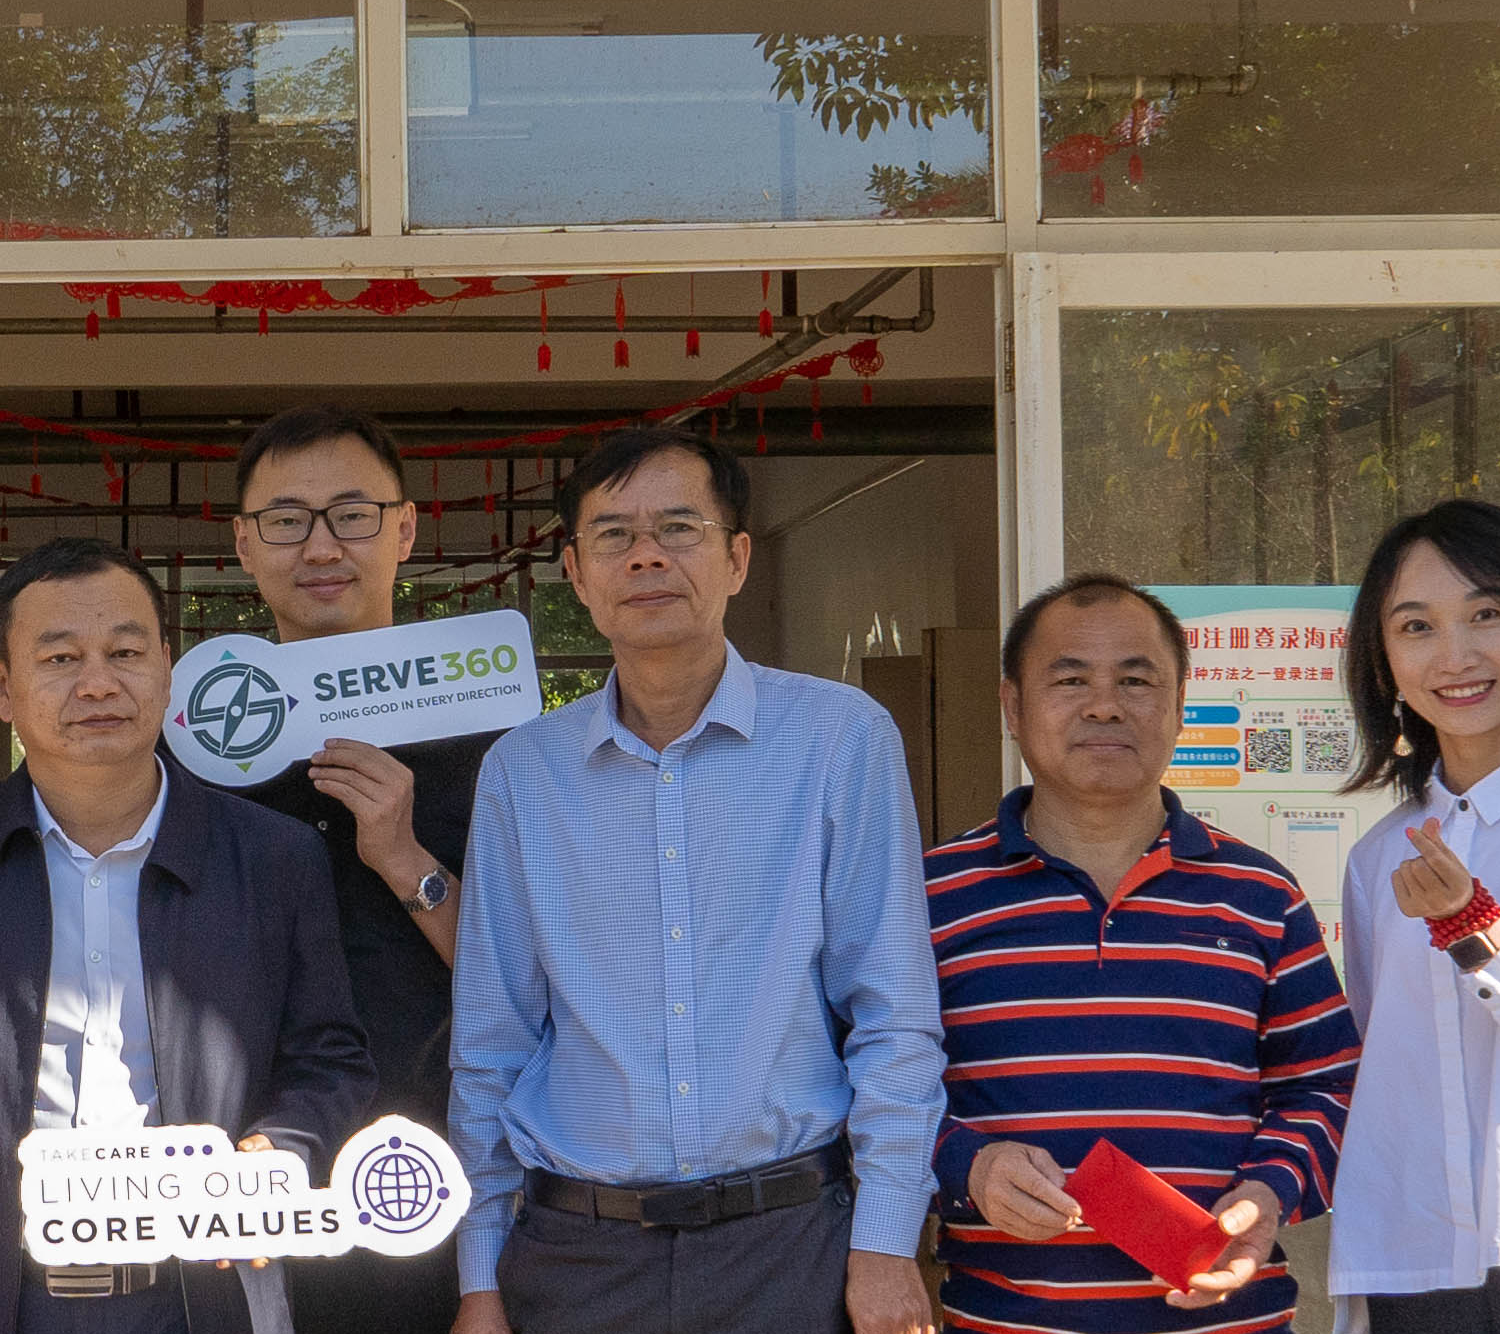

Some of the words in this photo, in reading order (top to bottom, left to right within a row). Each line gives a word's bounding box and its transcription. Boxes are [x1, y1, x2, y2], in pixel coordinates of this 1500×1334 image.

[313, 644, 518, 702] SERVE360
[320, 708, 359, 723] DOING
[362, 703, 399, 717] GOOD
[401, 700, 414, 710] IN
[416, 693, 454, 709] EVERY
[457, 683, 522, 703] DIRECTION
[41, 1173, 181, 1205] LIVING
[204, 1169, 291, 1198] OUR
[42, 1215, 156, 1245] CORE
[178, 1208, 340, 1239] VALUES
